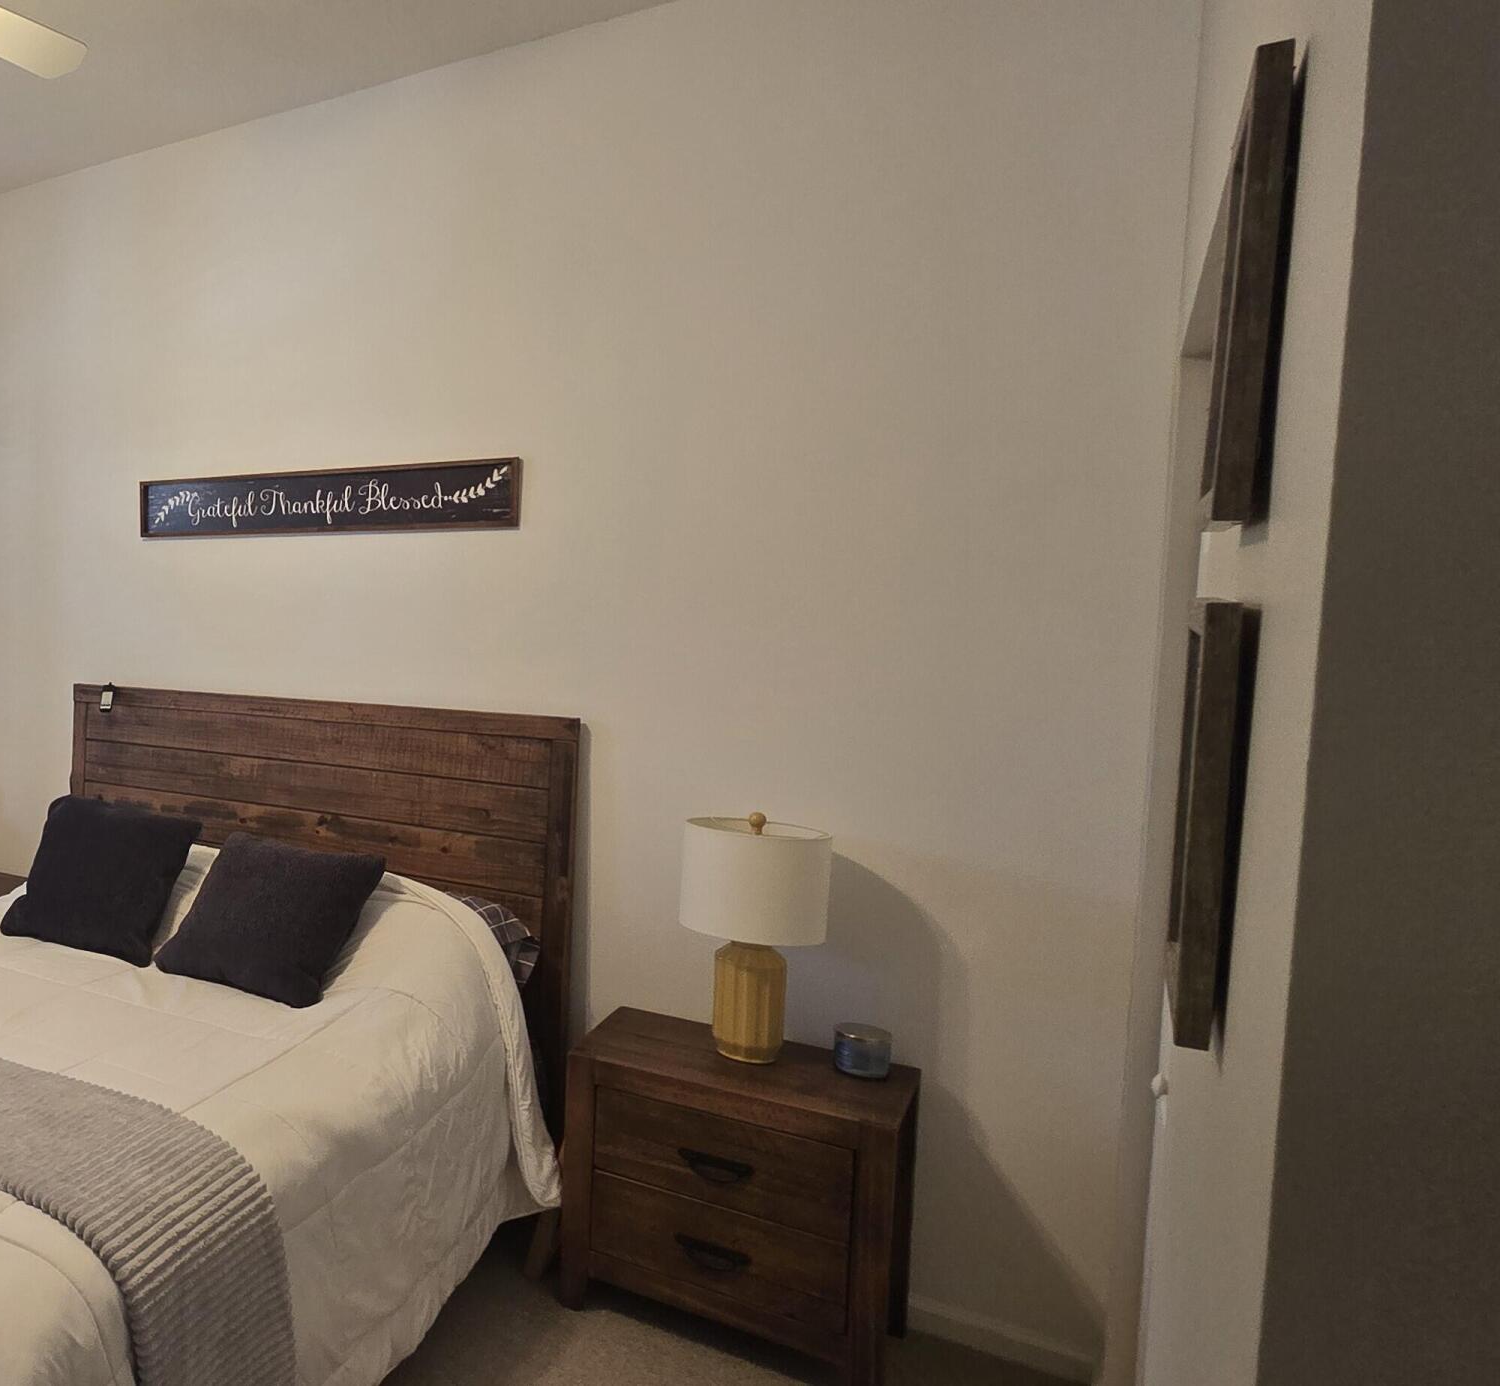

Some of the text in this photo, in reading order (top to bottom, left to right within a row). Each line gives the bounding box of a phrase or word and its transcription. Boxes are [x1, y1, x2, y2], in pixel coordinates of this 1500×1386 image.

[188, 479, 443, 528] Grateful Thankful Blessed
